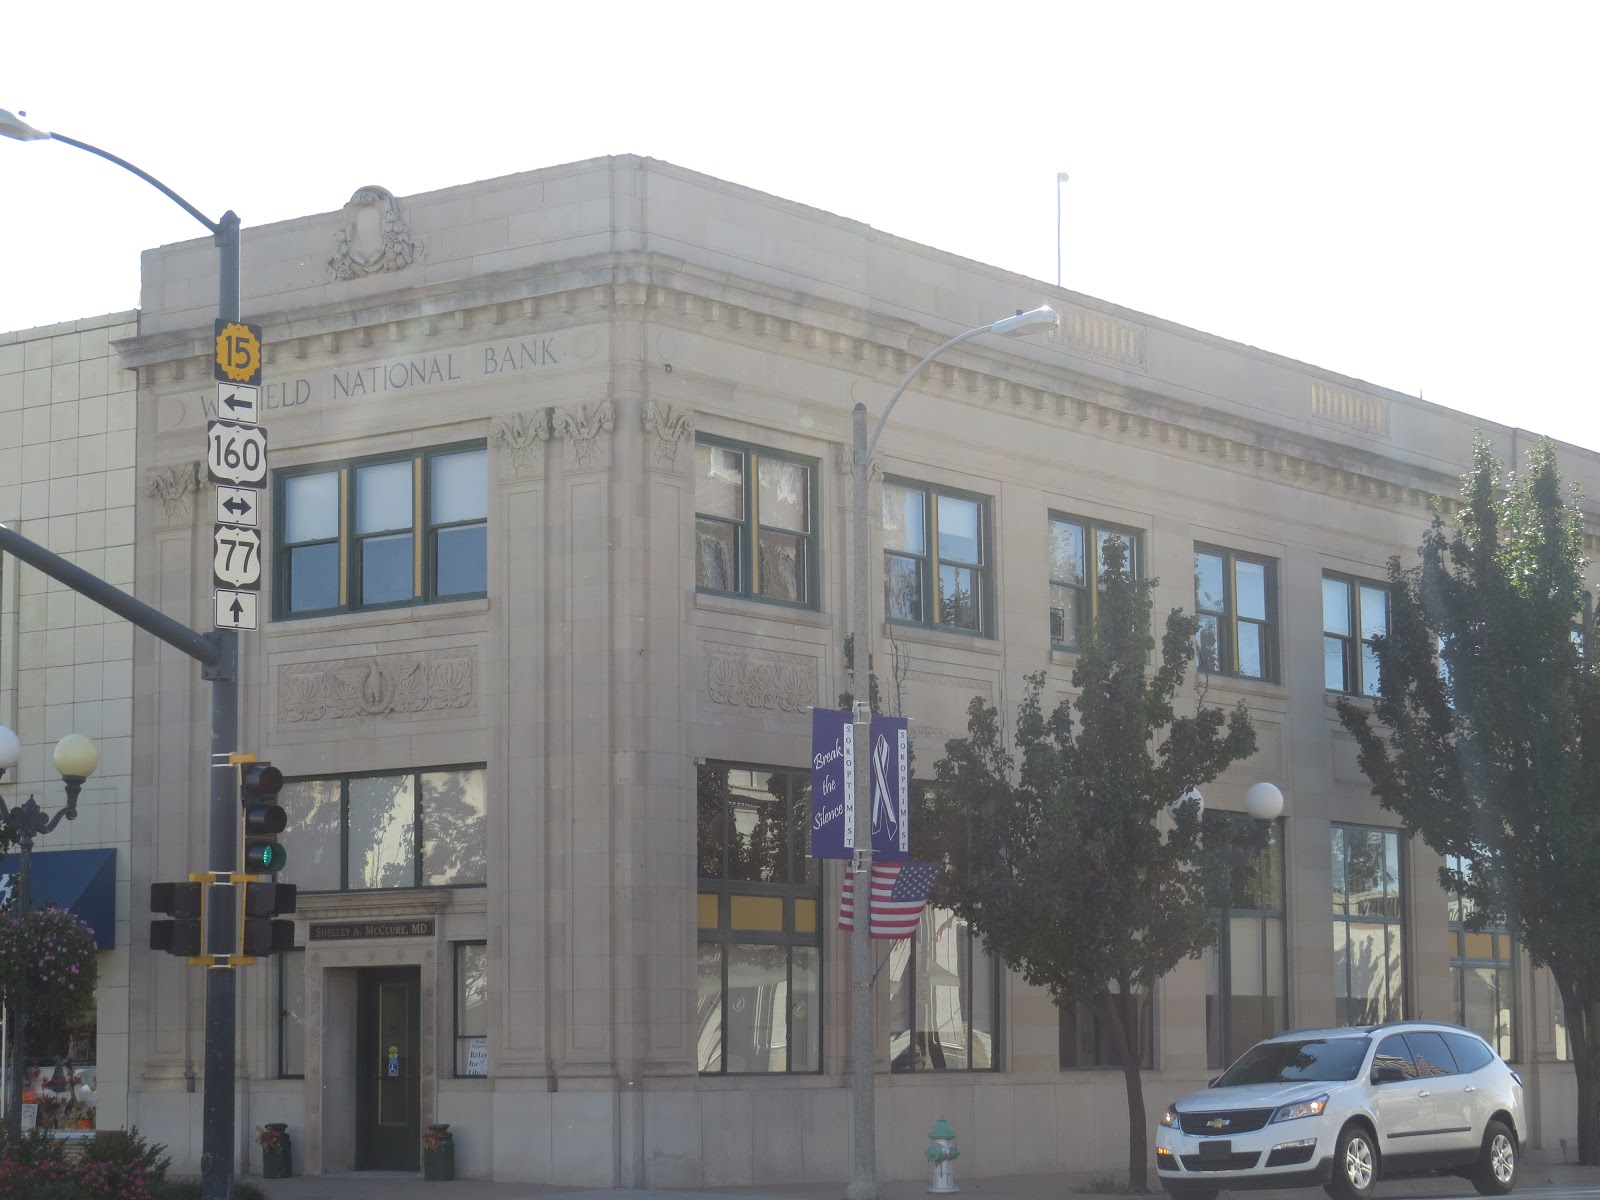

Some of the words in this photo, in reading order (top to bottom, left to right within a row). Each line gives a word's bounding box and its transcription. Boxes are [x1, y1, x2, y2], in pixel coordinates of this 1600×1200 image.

[225, 335, 251, 369] 15
[200, 379, 311, 418] WIELD
[333, 354, 461, 399] NATIONAL
[484, 338, 558, 374] BANK
[214, 434, 260, 471] 160
[220, 539, 255, 573] 77
[813, 738, 844, 770] Break
[822, 775, 836, 796] the
[813, 804, 844, 830] Silence
[315, 927, 351, 938] SHELLEY
[352, 927, 363, 936] A.
[411, 923, 427, 934] MD
[470, 1051, 487, 1060] Relay
